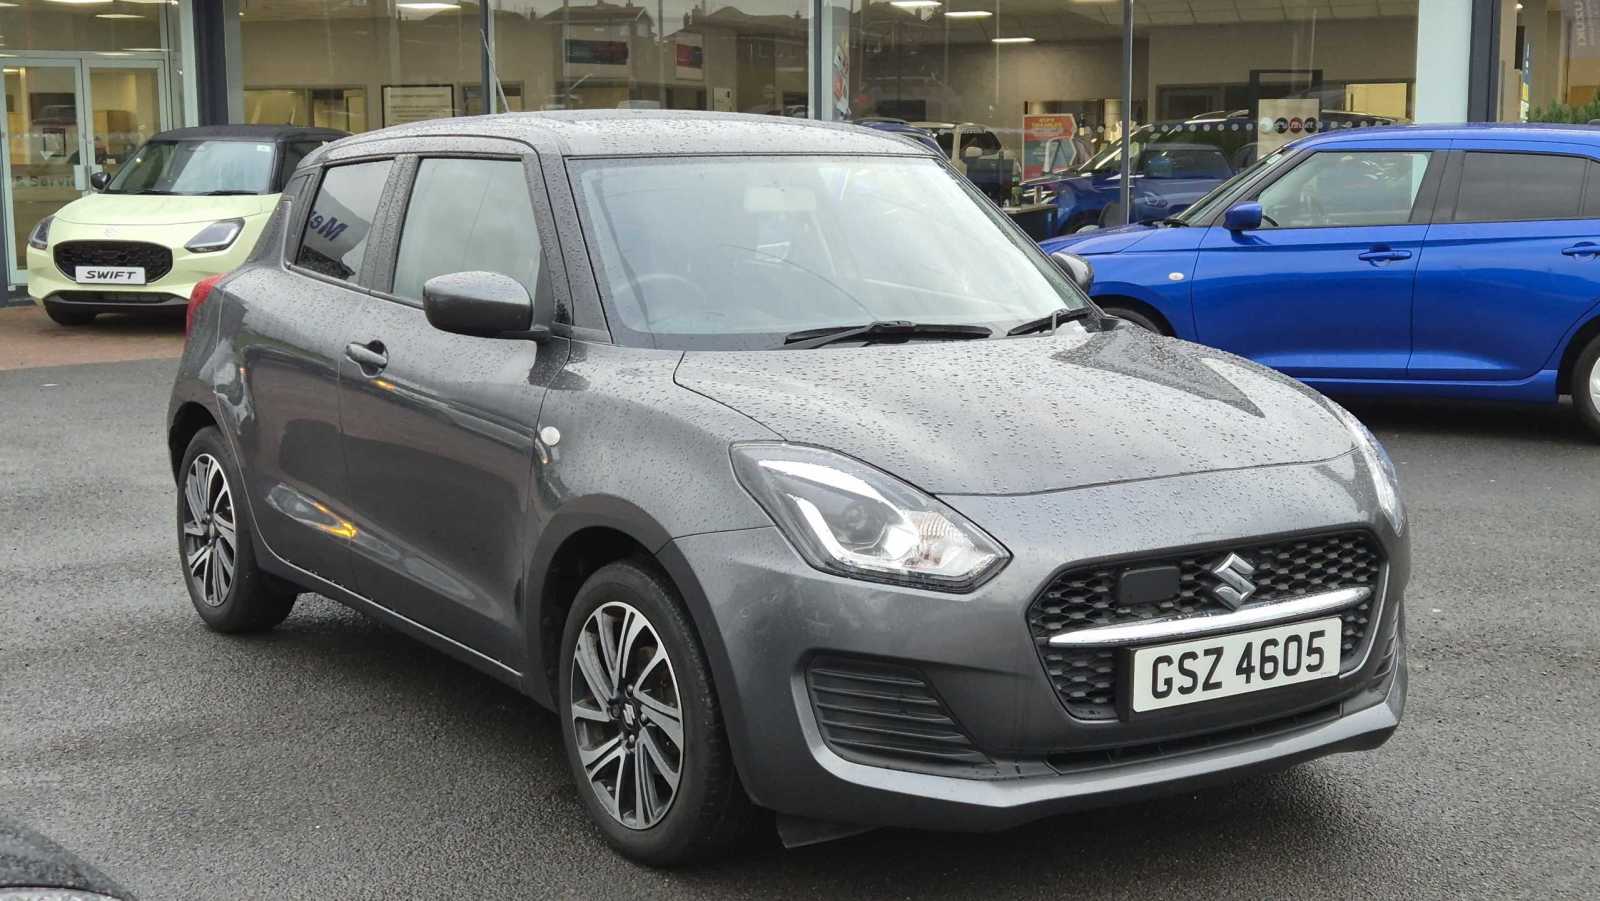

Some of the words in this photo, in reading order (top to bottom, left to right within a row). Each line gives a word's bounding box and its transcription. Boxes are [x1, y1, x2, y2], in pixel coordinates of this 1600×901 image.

[85, 270, 136, 280] SWIFT
[1152, 646, 1224, 699] GSZ
[1235, 630, 1326, 684] 4605
